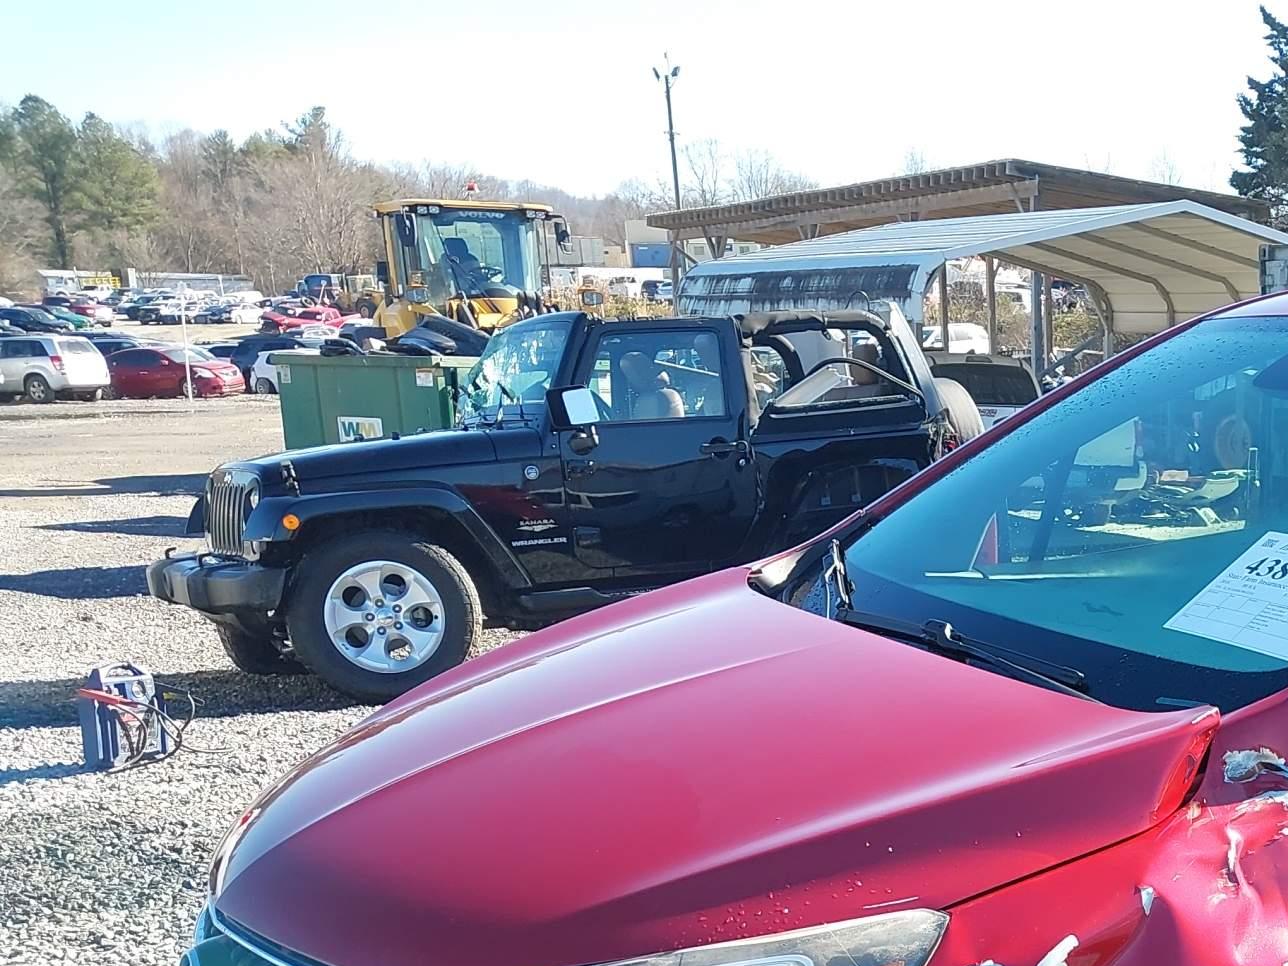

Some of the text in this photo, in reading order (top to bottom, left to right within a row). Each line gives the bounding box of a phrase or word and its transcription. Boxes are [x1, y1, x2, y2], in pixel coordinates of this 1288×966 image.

[459, 211, 505, 219] VOLVO
[341, 421, 378, 437] WM
[511, 537, 568, 547] WRANGLER
